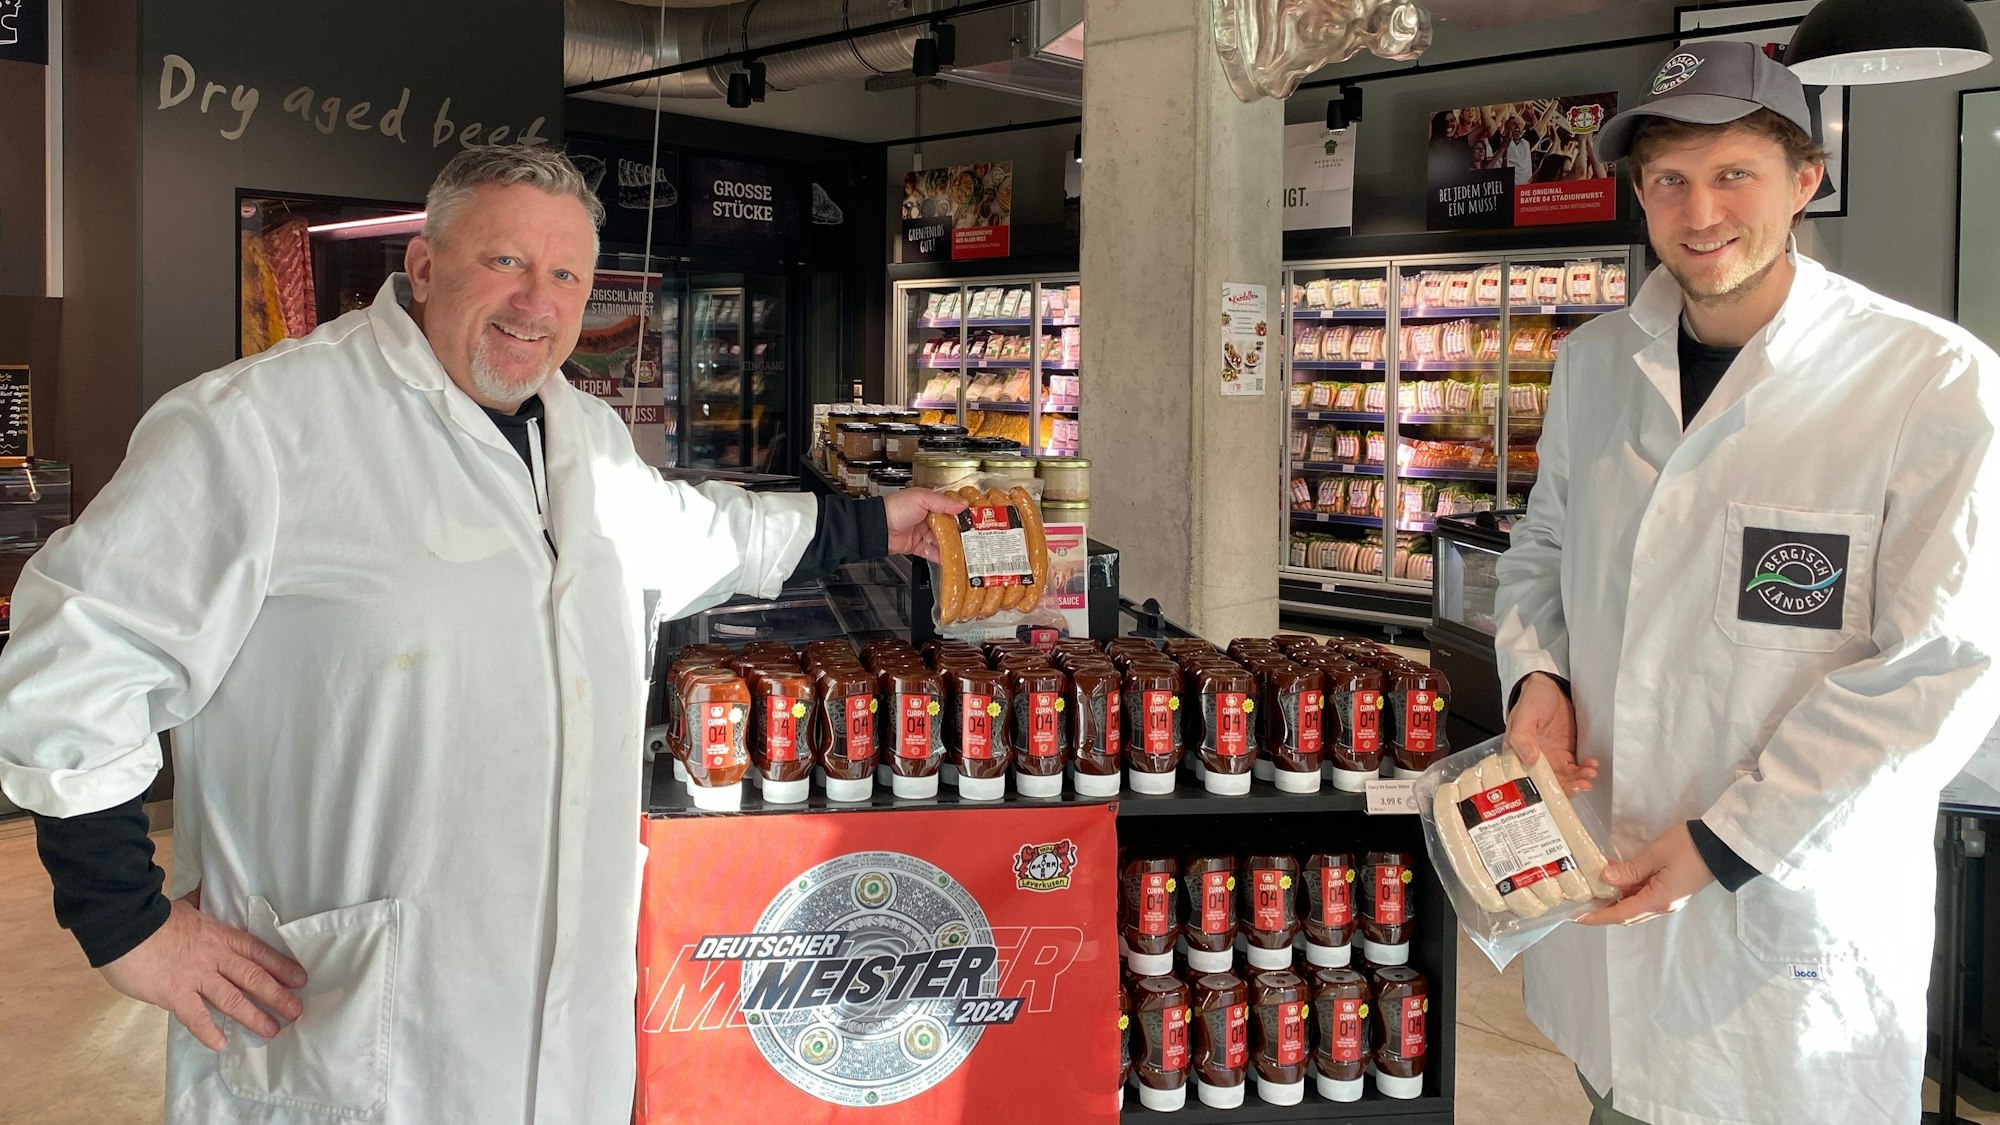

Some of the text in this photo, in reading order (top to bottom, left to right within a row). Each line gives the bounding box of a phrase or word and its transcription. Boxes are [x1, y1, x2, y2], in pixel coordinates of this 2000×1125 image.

[157, 54, 260, 140] Dry
[283, 86, 411, 145] aged
[713, 180, 772, 201] GROSSE
[1283, 187, 1309, 208] IGT.
[1439, 180, 1504, 203] BEI JEDEM SPIEL
[1520, 196, 1541, 204] BAYER
[1552, 191, 1605, 202] STADIONWURST.
[1532, 188, 1563, 196] ORIGINAL
[712, 200, 773, 221] STÜCKE
[1449, 196, 1497, 217] EIN MUSS!
[908, 224, 945, 242] GRENZENLOS
[920, 238, 936, 253] GUT!
[588, 288, 654, 304] RGISCHLÄNDER
[592, 302, 654, 317] STADIONWUST
[743, 360, 785, 371] EINGANG
[1764, 548, 1830, 576] BERGISCH
[1058, 596, 1080, 605] SAUCE
[1764, 585, 1825, 610] LÄNDER
[852, 709, 869, 718] CURRY
[1036, 706, 1053, 714] CURRY
[1304, 704, 1318, 712] CURRY
[1360, 704, 1376, 712] CURRY
[773, 718, 790, 736] 04
[853, 718, 869, 735] 04
[907, 717, 925, 733] 04
[968, 716, 986, 733] 04
[1036, 714, 1052, 731] 04
[1150, 712, 1167, 729] 04
[1223, 714, 1240, 730] 04
[1305, 712, 1318, 728] 04
[1360, 712, 1375, 728] 04
[1412, 712, 1430, 729] 04
[1397, 797, 1402, 805] €
[1031, 861, 1057, 869] BAYER
[1022, 879, 1065, 888] Leverkusen
[1208, 886, 1226, 894] CURRY
[1328, 879, 1345, 888] CURRY
[1260, 890, 1277, 906] 04
[1330, 886, 1344, 902] 04
[1382, 884, 1399, 900] 04
[1147, 894, 1163, 910] 04
[1209, 893, 1224, 910] 04
[695, 934, 841, 959] DEUTSCHER
[743, 946, 997, 1010] MEISTER
[1793, 964, 1817, 977] boco
[955, 1000, 1020, 1024] 2024
[1284, 1016, 1300, 1024] CURRY
[1408, 1010, 1422, 1018] CURRY
[1168, 1020, 1184, 1030] CURRY
[1286, 1022, 1300, 1040] 04
[1340, 1020, 1356, 1036] 04
[1408, 1018, 1421, 1034] 04
[1170, 1028, 1184, 1045] 04
[1232, 1026, 1244, 1043] 04
